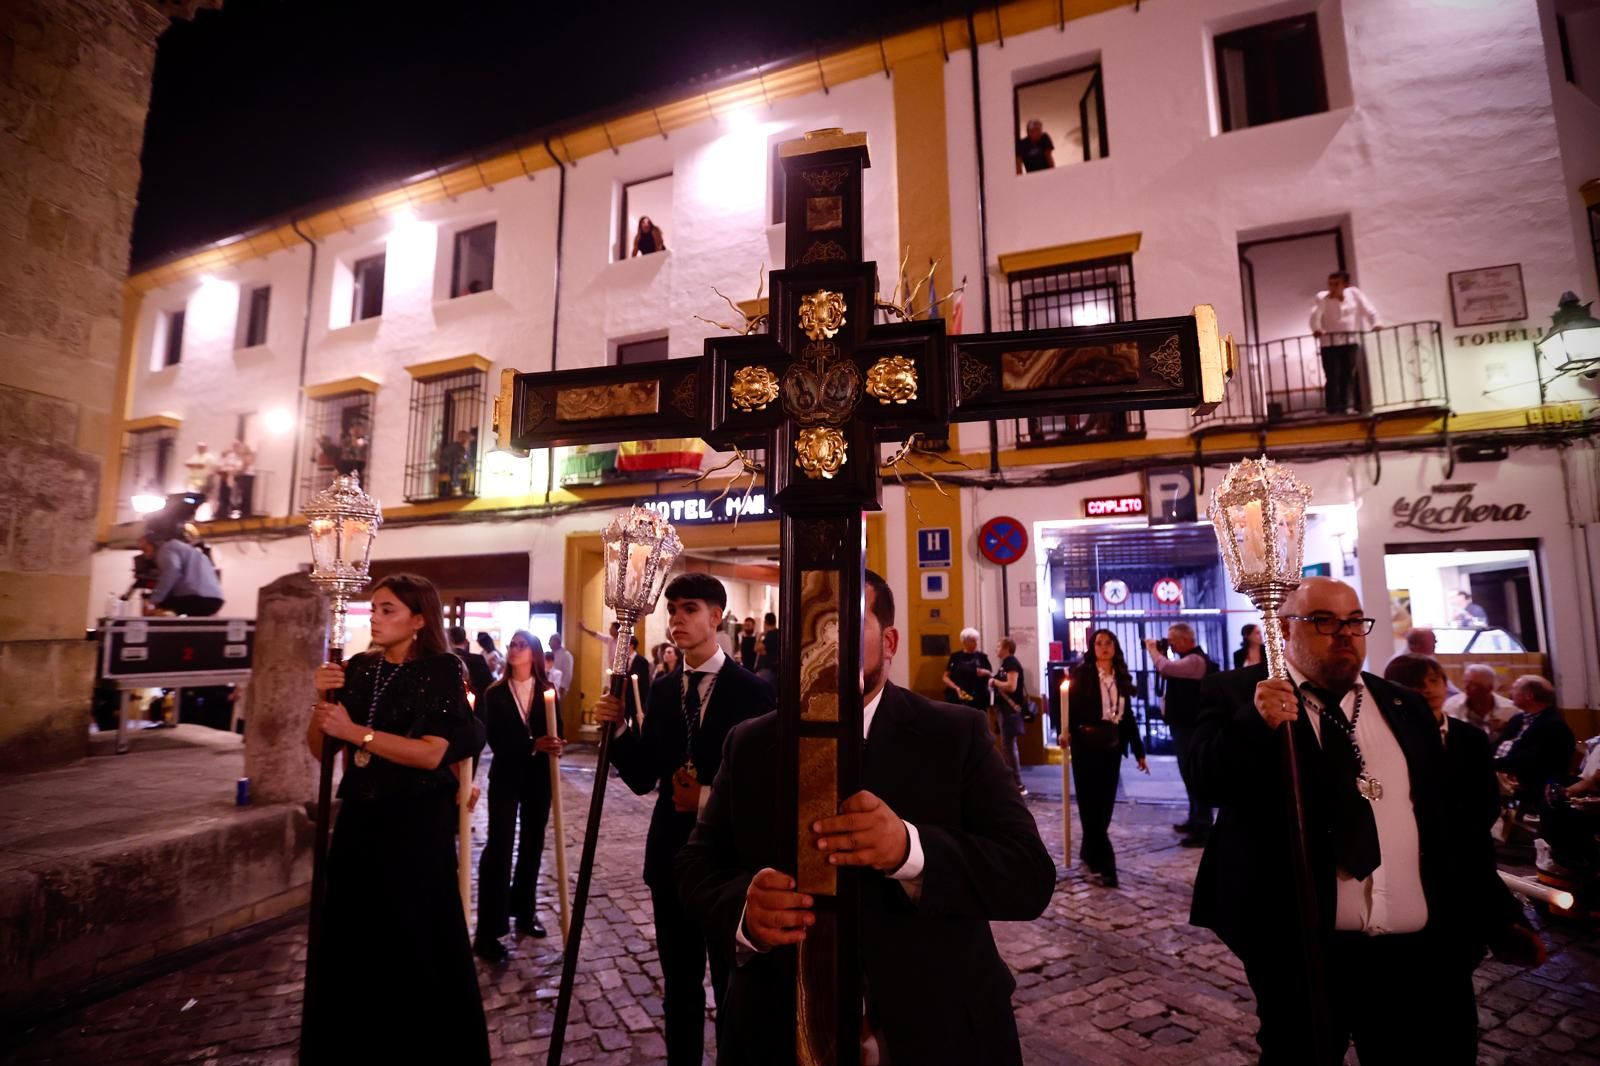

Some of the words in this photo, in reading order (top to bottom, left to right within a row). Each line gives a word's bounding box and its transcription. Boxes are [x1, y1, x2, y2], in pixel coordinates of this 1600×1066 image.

[1087, 498, 1142, 515] COMPLETO
[1149, 474, 1191, 518] P
[645, 499, 713, 521] HOTEL
[1394, 494, 1532, 533] Lechera
[927, 532, 941, 551] H
